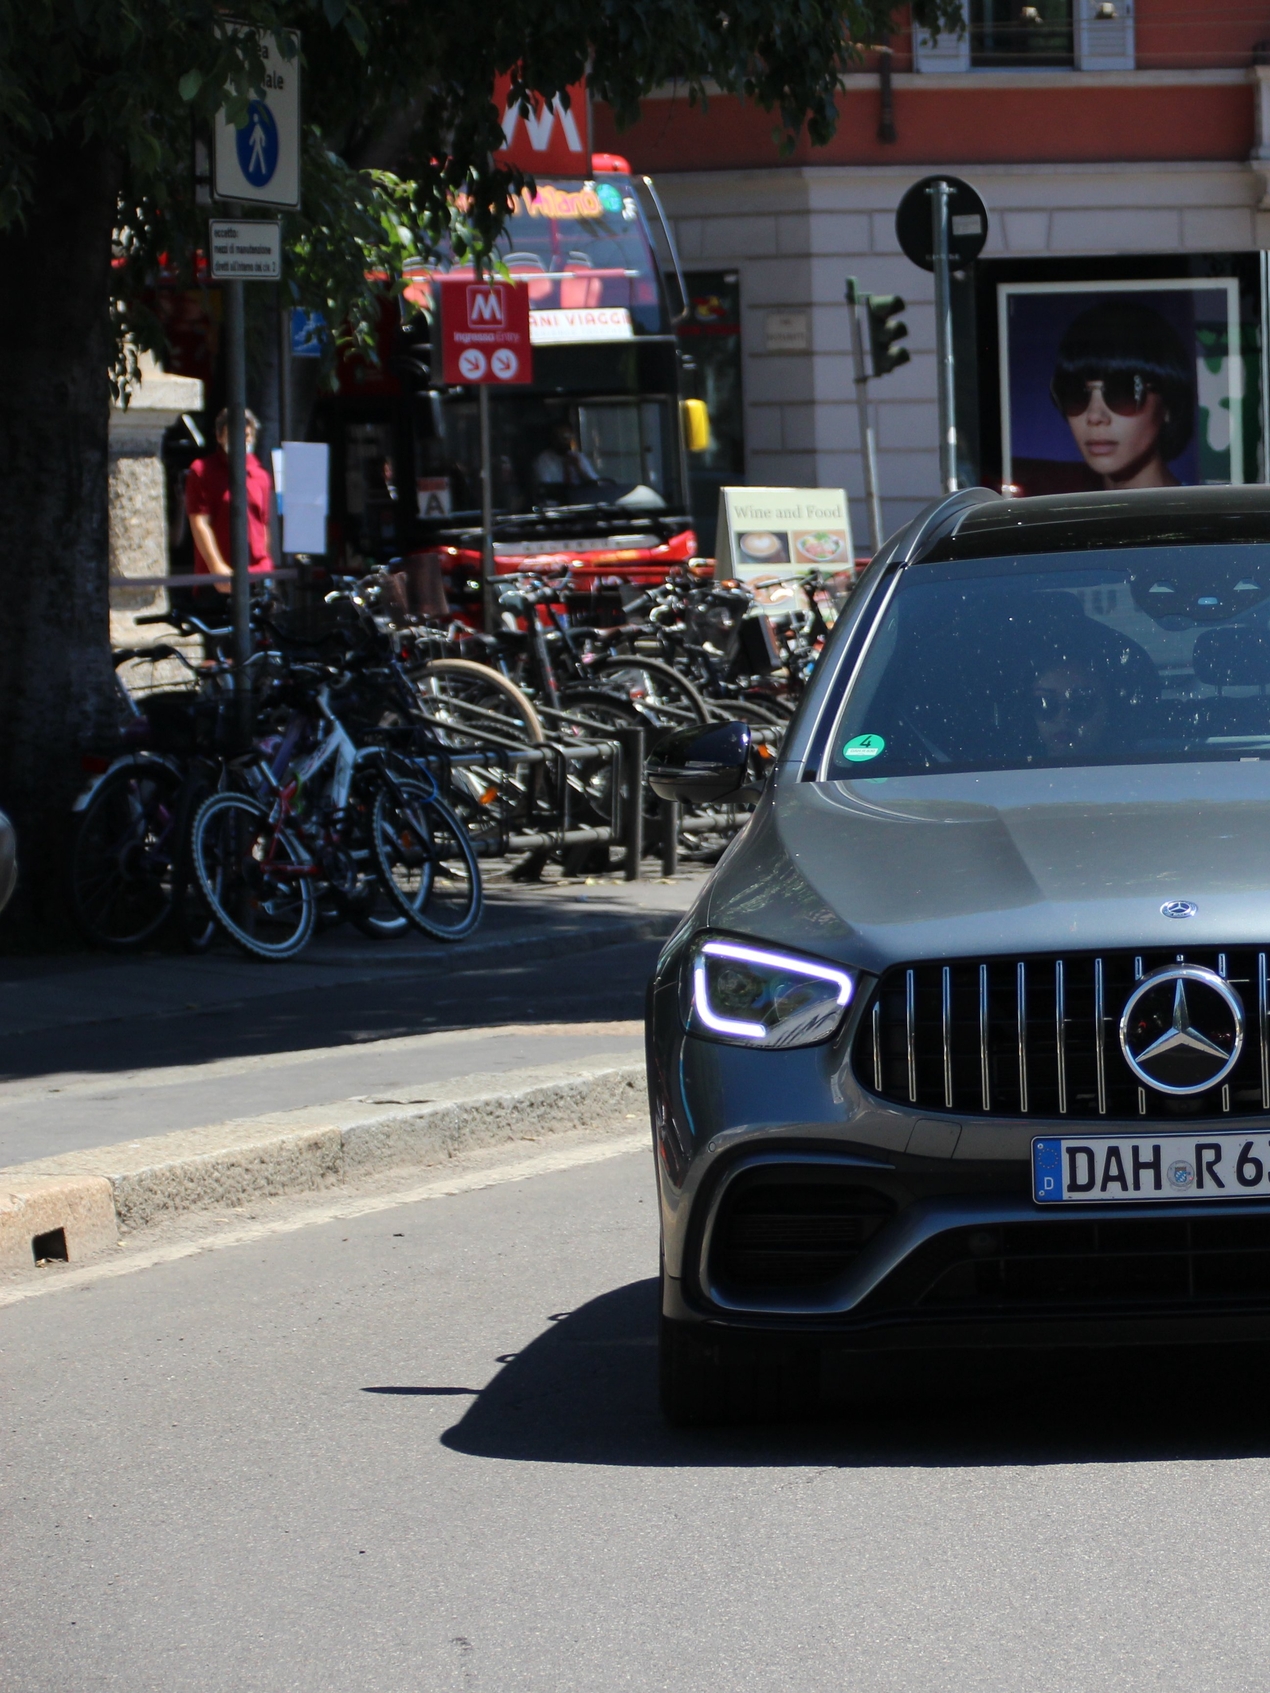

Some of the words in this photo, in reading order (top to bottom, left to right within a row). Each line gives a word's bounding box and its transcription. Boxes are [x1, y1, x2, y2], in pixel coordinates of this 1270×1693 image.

[471, 292, 502, 321] M
[530, 316, 559, 328] ANI
[734, 504, 771, 519] Wine
[776, 504, 802, 519] and
[806, 504, 842, 519] Food
[860, 735, 871, 748] 4
[1066, 1145, 1162, 1193] DAH
[1195, 1143, 1225, 1189] R
[1043, 1177, 1054, 1190] D
